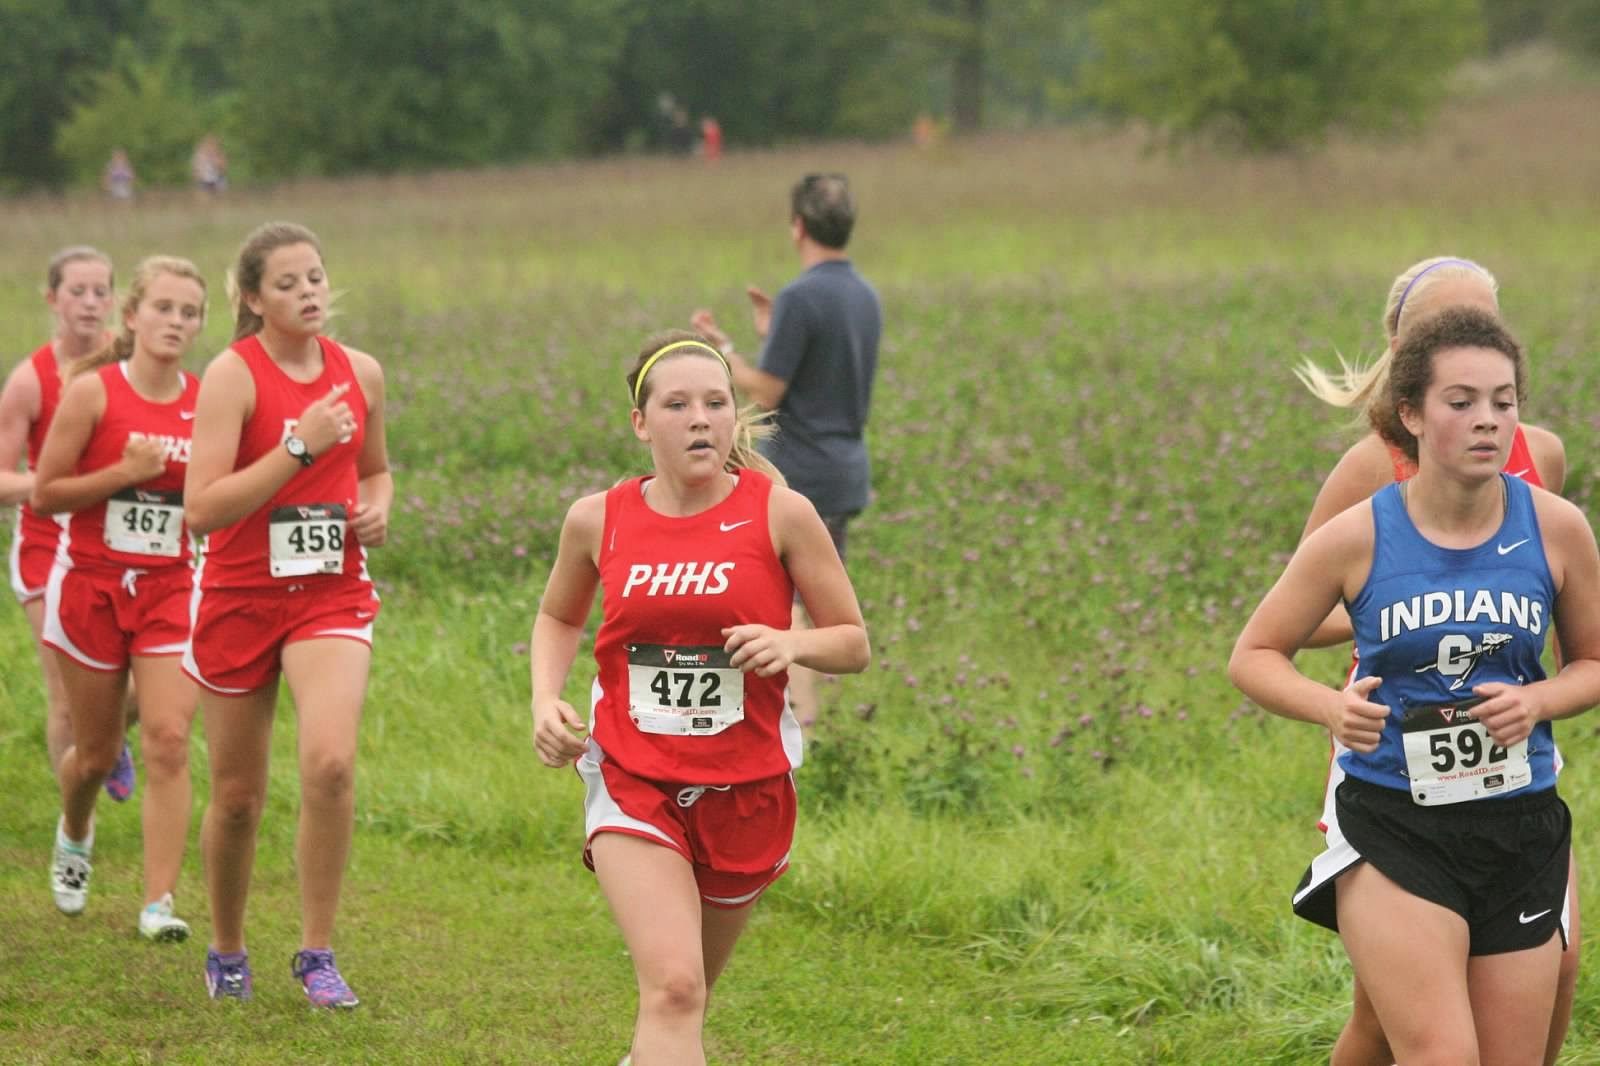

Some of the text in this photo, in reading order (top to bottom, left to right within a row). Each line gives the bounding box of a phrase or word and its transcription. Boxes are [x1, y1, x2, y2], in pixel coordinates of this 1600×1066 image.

[123, 506, 171, 534] 467
[288, 523, 343, 553] 458
[622, 561, 736, 598] PHHS
[1380, 589, 1543, 642] INDIANS
[650, 670, 721, 708] 472
